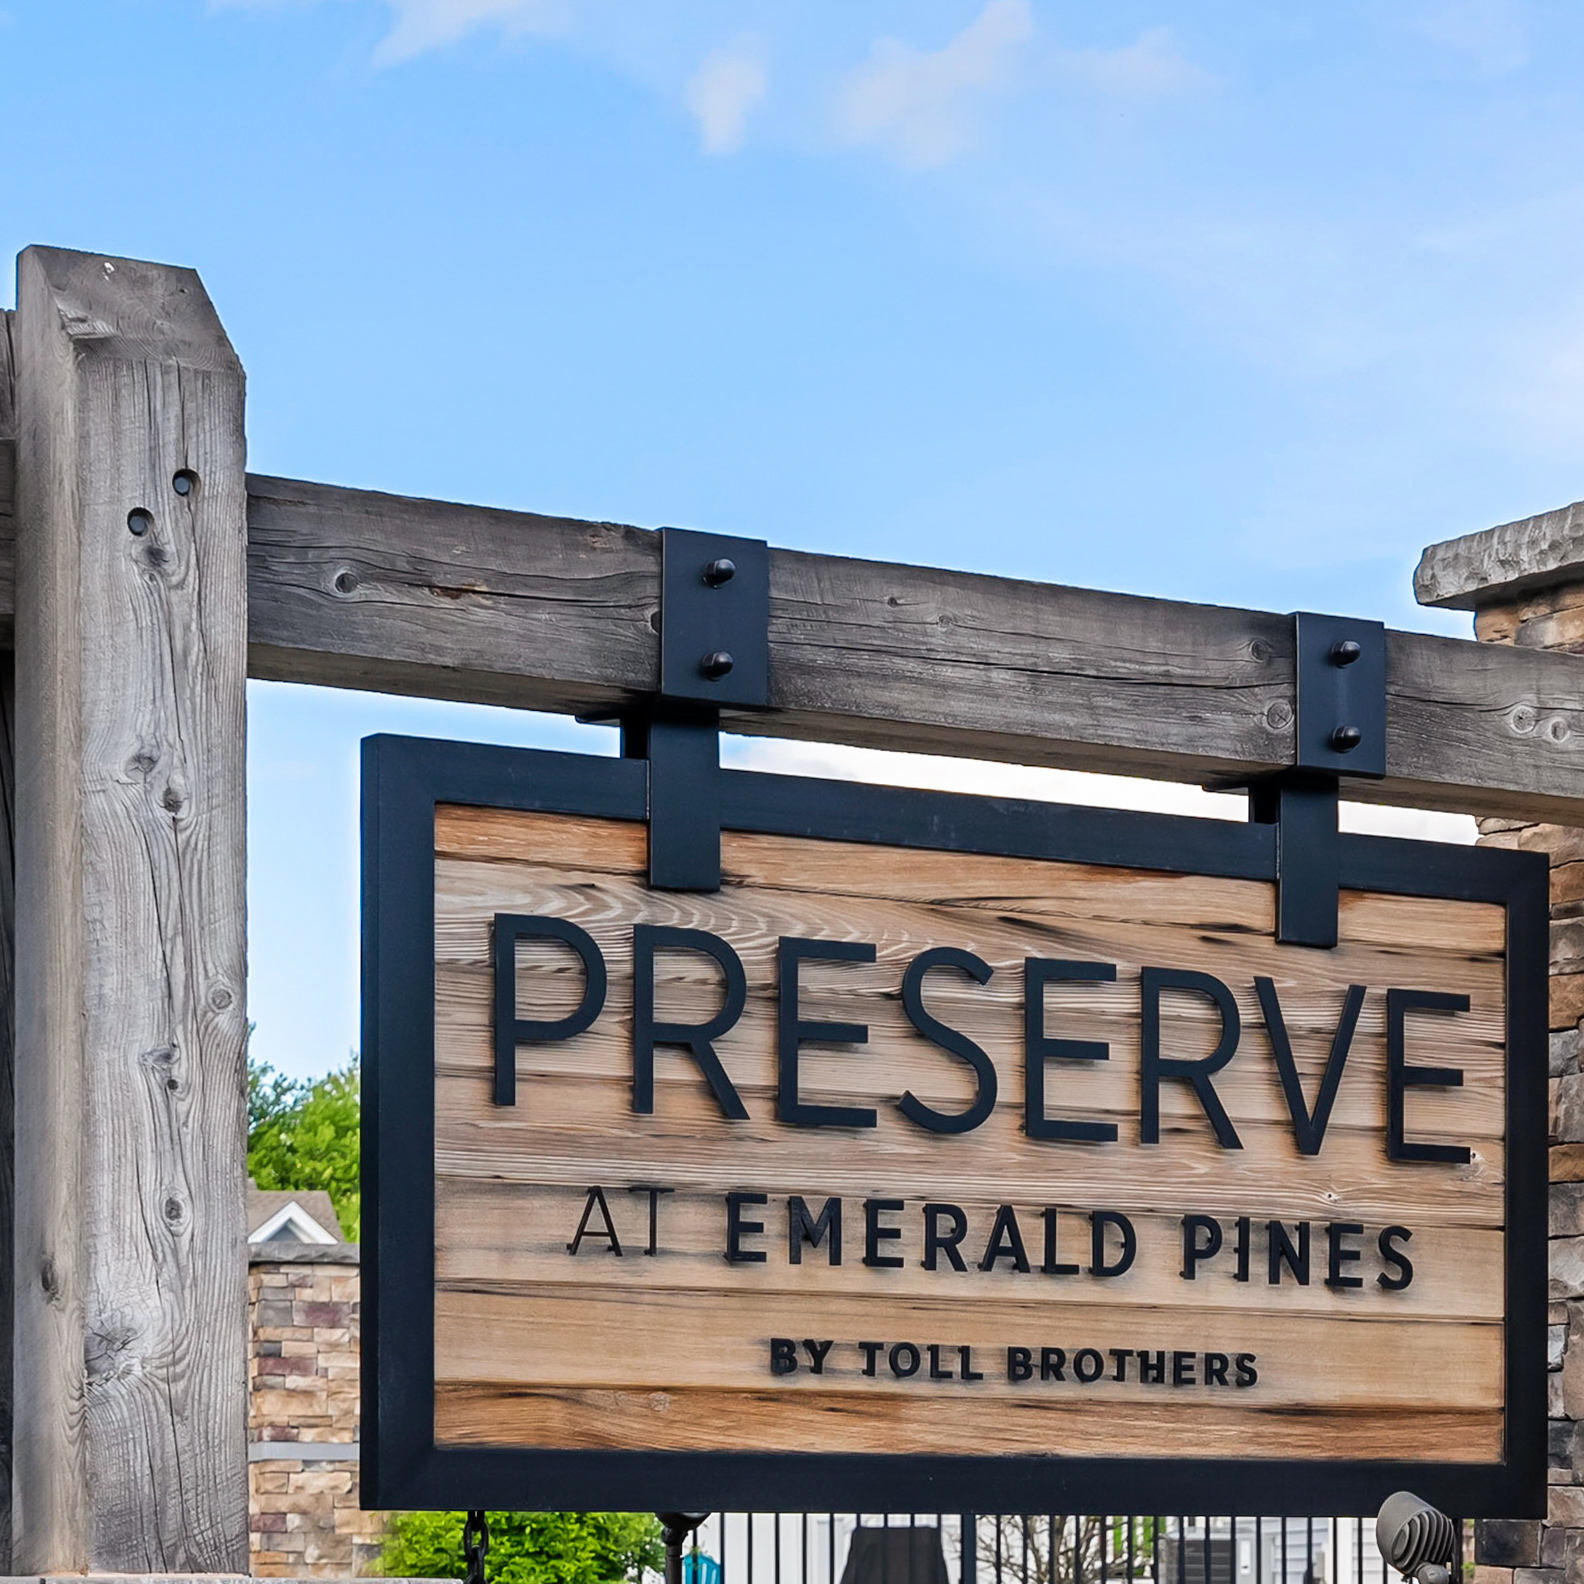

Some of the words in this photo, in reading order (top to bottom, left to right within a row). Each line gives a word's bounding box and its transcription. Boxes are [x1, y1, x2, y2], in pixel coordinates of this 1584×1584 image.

[493, 913, 1472, 1164] PRESERVE
[567, 1185, 674, 1257] AT
[725, 1192, 1137, 1277] EMERALD
[1180, 1214, 1414, 1291] PINES
[770, 1337, 833, 1375] BY
[859, 1341, 983, 1380] TOLL
[1007, 1346, 1258, 1388] BROTHERS
